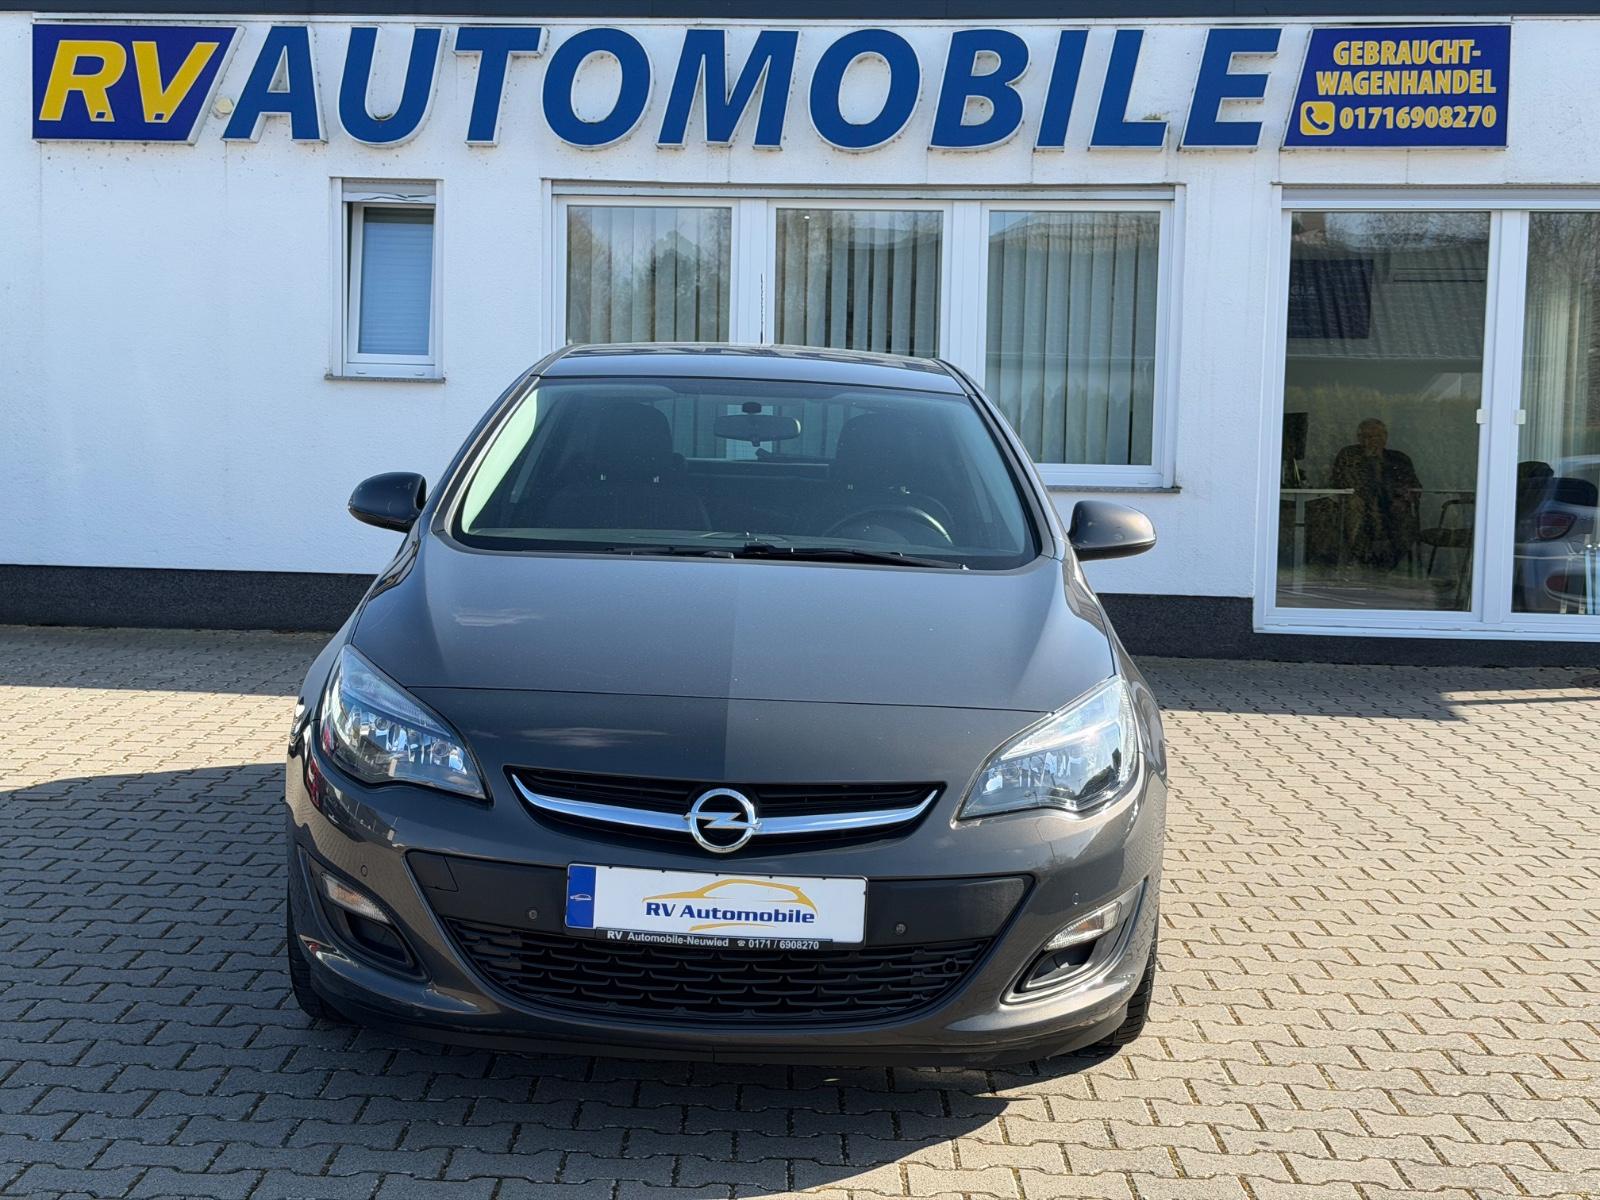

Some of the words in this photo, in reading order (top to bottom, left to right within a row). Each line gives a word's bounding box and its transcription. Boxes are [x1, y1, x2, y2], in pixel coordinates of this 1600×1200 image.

[1333, 39, 1482, 66] GEBRAUCHT-
[222, 25, 1282, 150] AUTOMOBILE
[1316, 69, 1497, 96] WAGENHANDEL
[1339, 105, 1497, 129] 01716908270
[645, 902, 677, 917] RV
[679, 904, 816, 924] Automobile
[606, 930, 623, 941] RV
[627, 931, 729, 948] Automobile-Neuwied
[748, 939, 772, 949] 0171
[779, 940, 820, 950] 6908270
